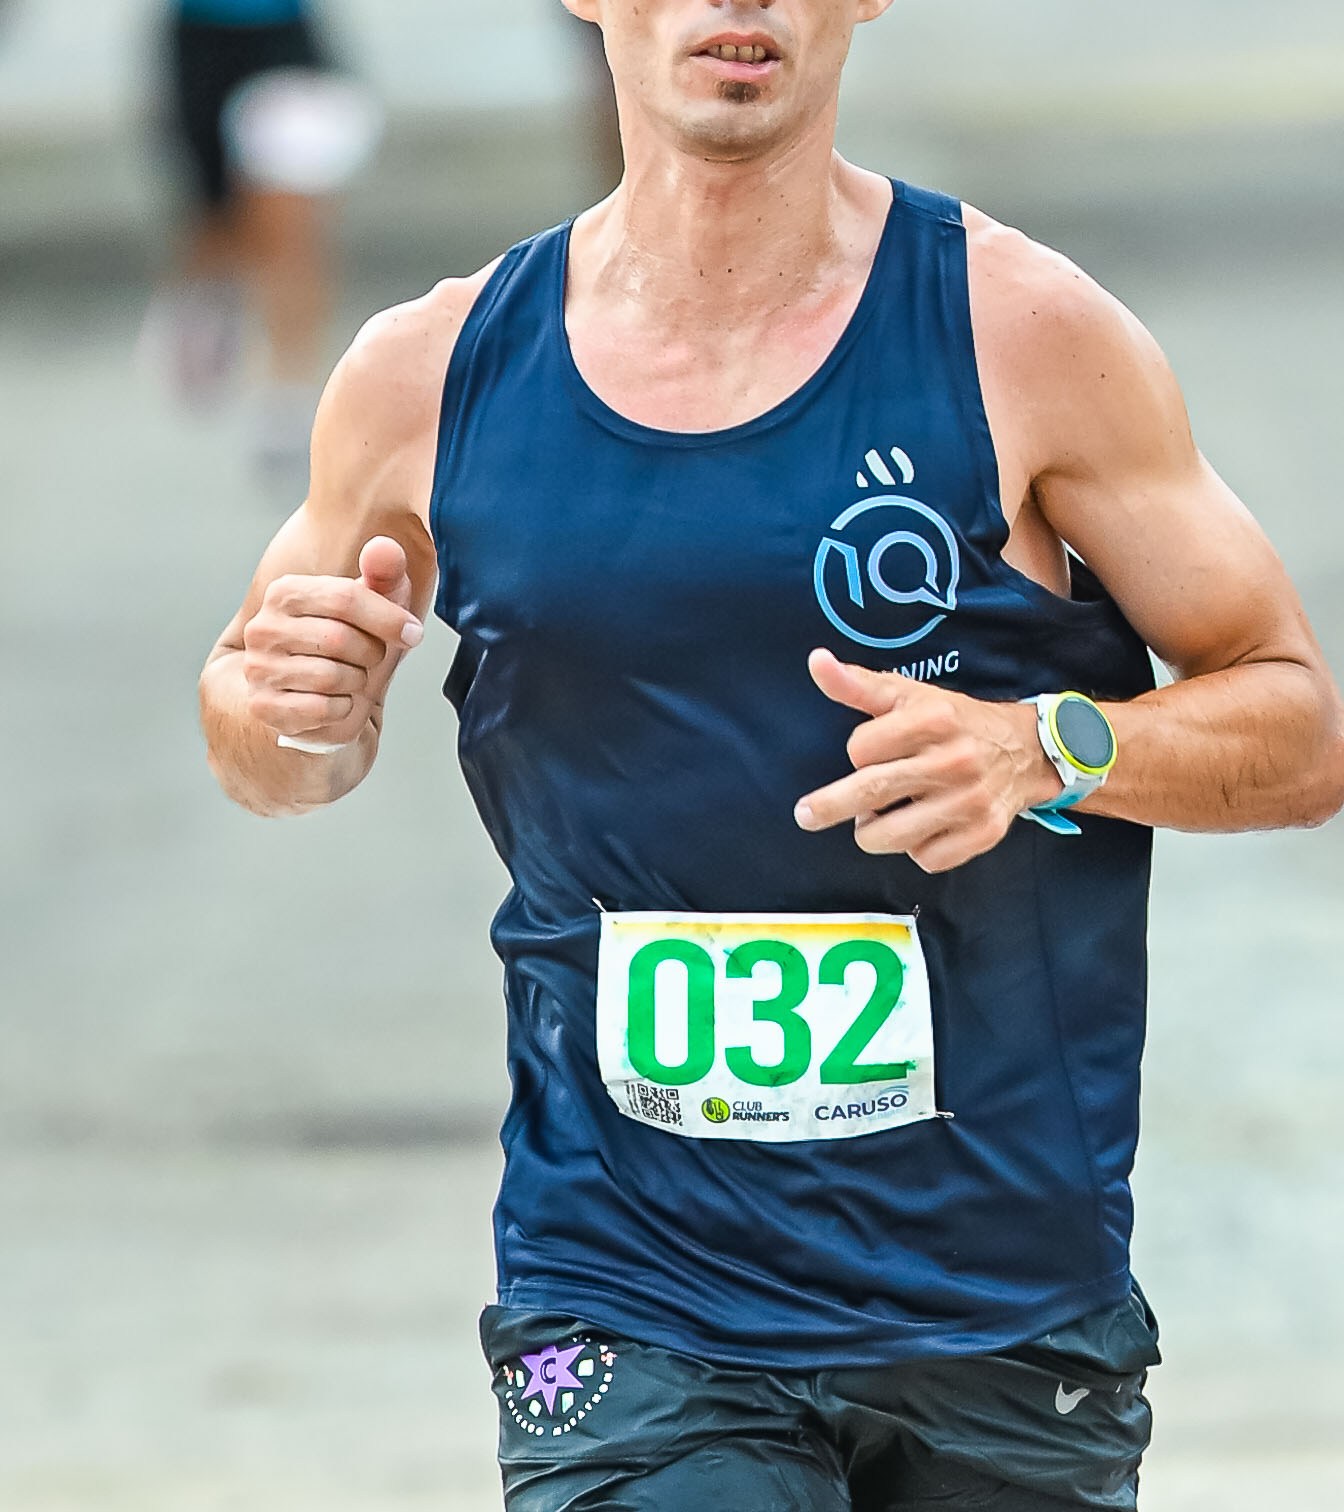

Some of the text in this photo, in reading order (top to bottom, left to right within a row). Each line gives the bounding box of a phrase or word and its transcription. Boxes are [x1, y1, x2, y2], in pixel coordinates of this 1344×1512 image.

[881, 650, 960, 682] NING
[626, 938, 908, 1088] 032
[732, 1101, 763, 1112] CLUB
[732, 1112, 790, 1122] RUNNER'S
[814, 1093, 908, 1121] CARUSO
